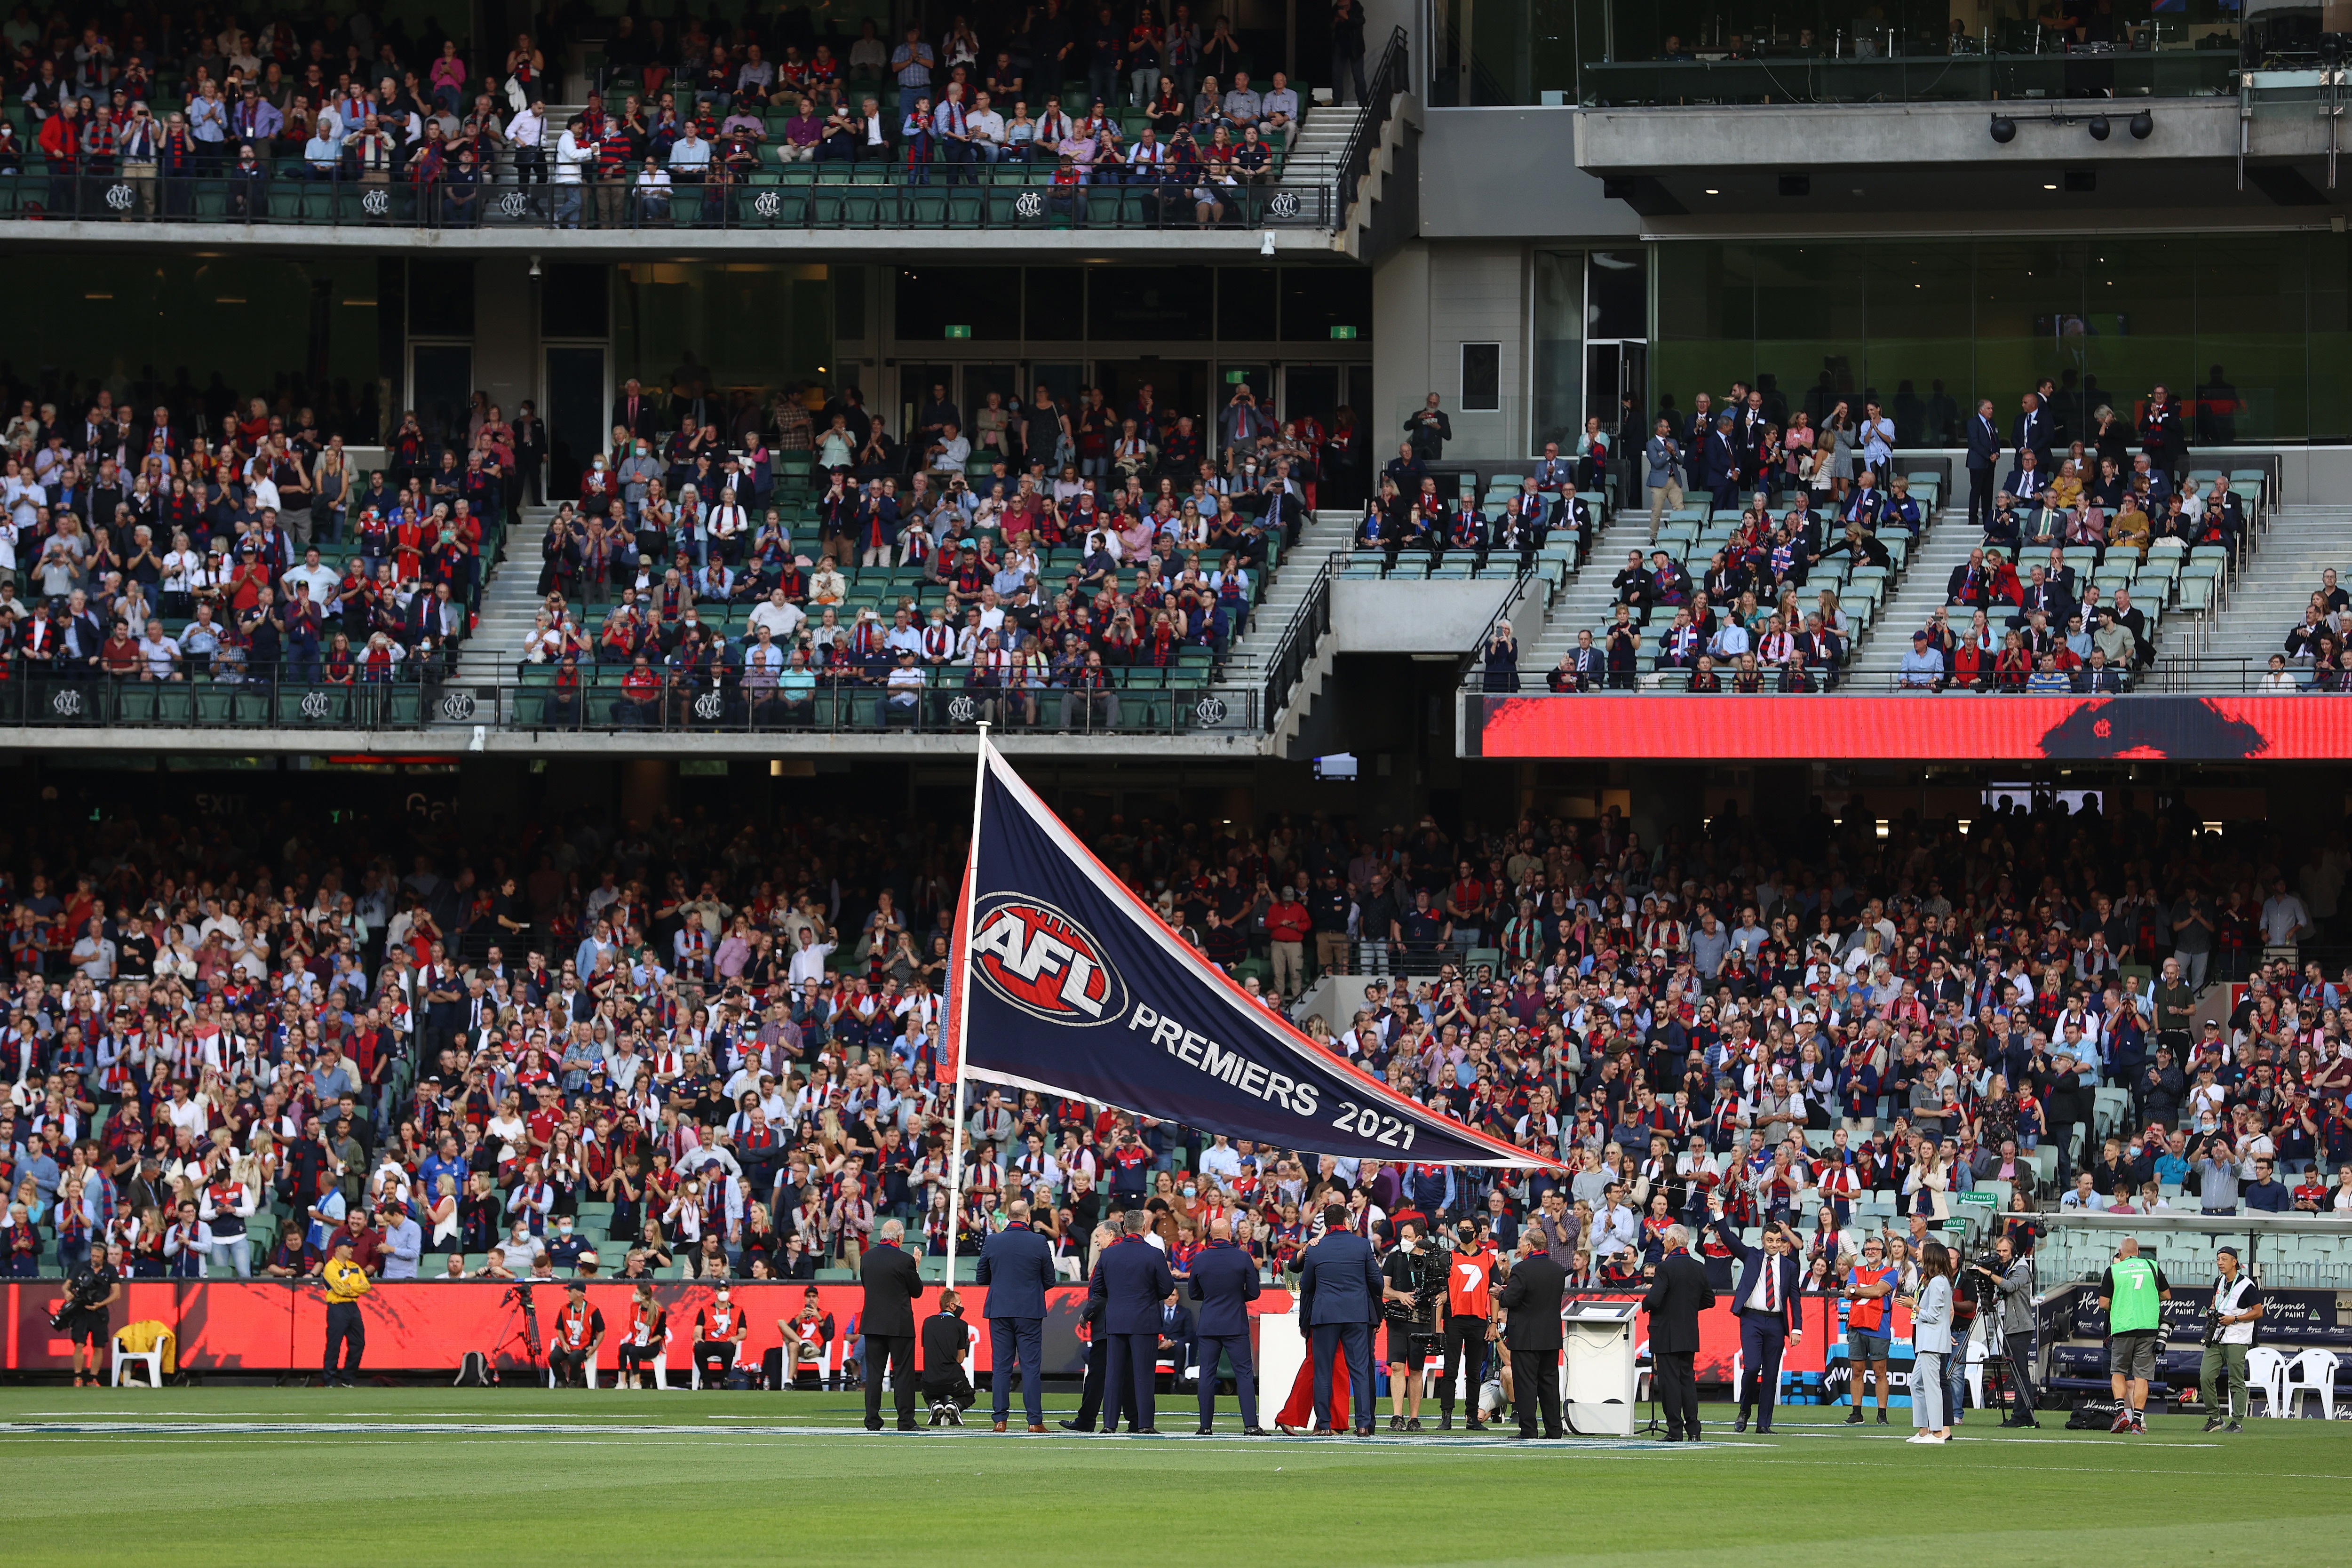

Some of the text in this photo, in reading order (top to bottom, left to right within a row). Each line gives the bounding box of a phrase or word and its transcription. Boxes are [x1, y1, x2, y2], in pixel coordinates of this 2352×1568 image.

[196, 794, 248, 814] EXIT
[406, 792, 459, 822] Gat
[972, 909, 1102, 1018] AFL
[1129, 1003, 1415, 1150] PREMIERS 2021
[1457, 1264, 1483, 1292] 7
[2131, 1274, 2144, 1290] 7
[2078, 1291, 2099, 1314] Hay
[2160, 1300, 2195, 1316] aymes
[2262, 1296, 2305, 1319] Haymes
[802, 1322, 816, 1338] 7
[2334, 1404, 2352, 1419] Hay
